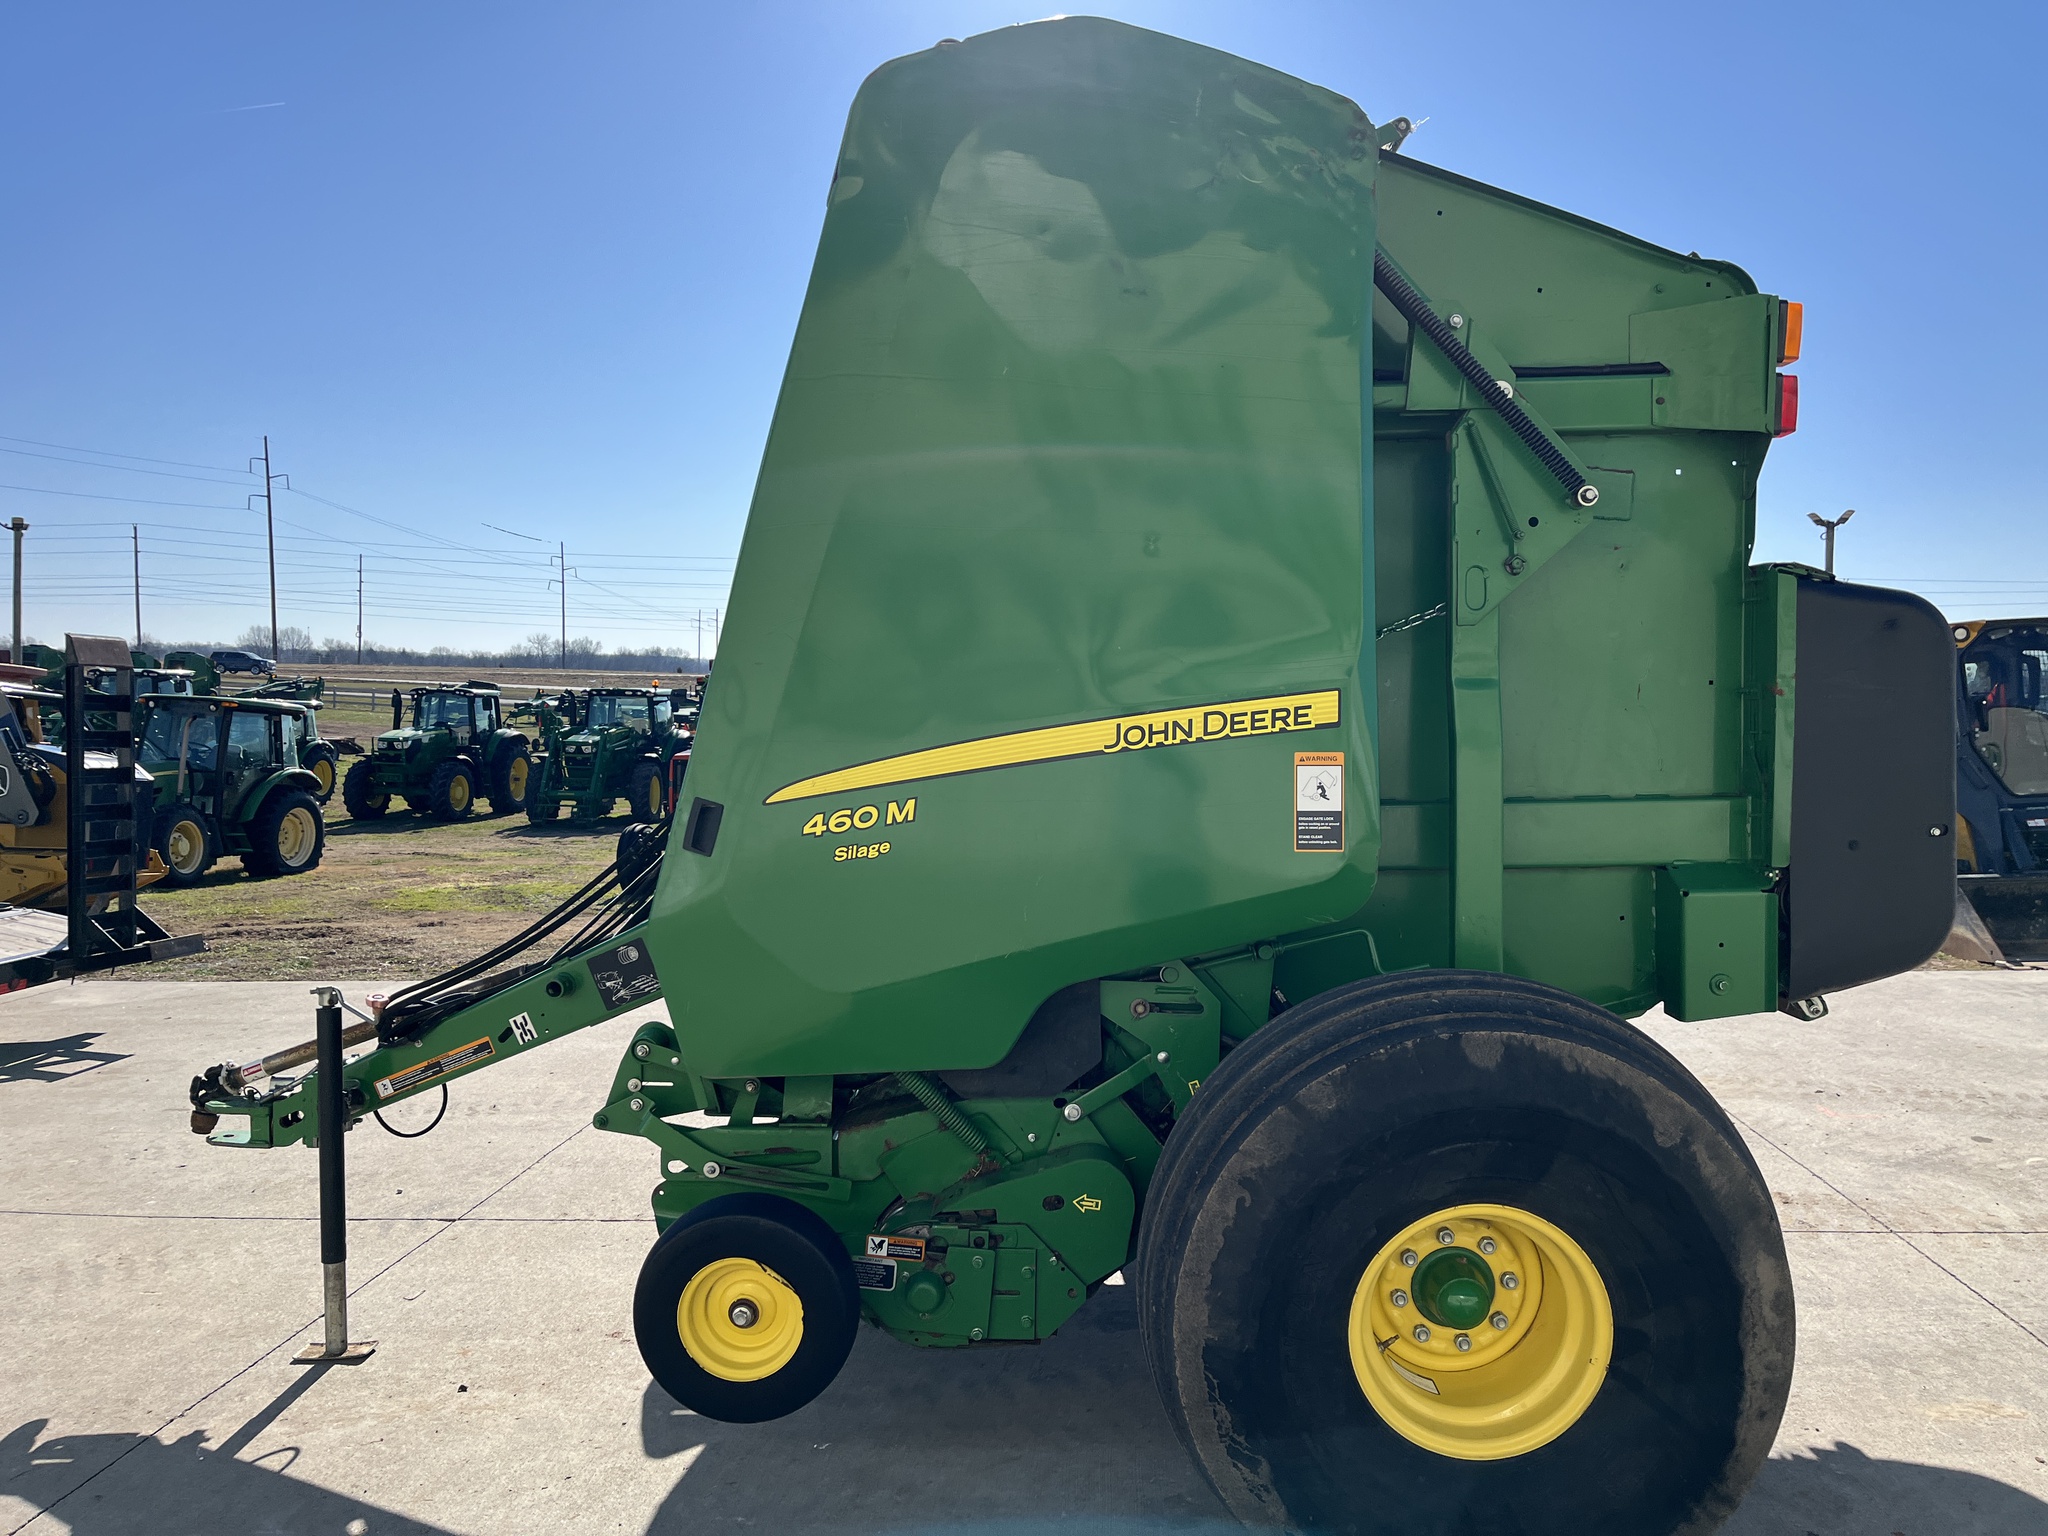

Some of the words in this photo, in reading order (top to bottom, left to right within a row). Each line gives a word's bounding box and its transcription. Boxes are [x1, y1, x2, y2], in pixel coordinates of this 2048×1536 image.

[1104, 718, 1193, 750] JOHN
[1203, 705, 1312, 737] DEERE
[802, 805, 880, 837] 460
[885, 797, 917, 826] M
[834, 842, 891, 862] Silage
